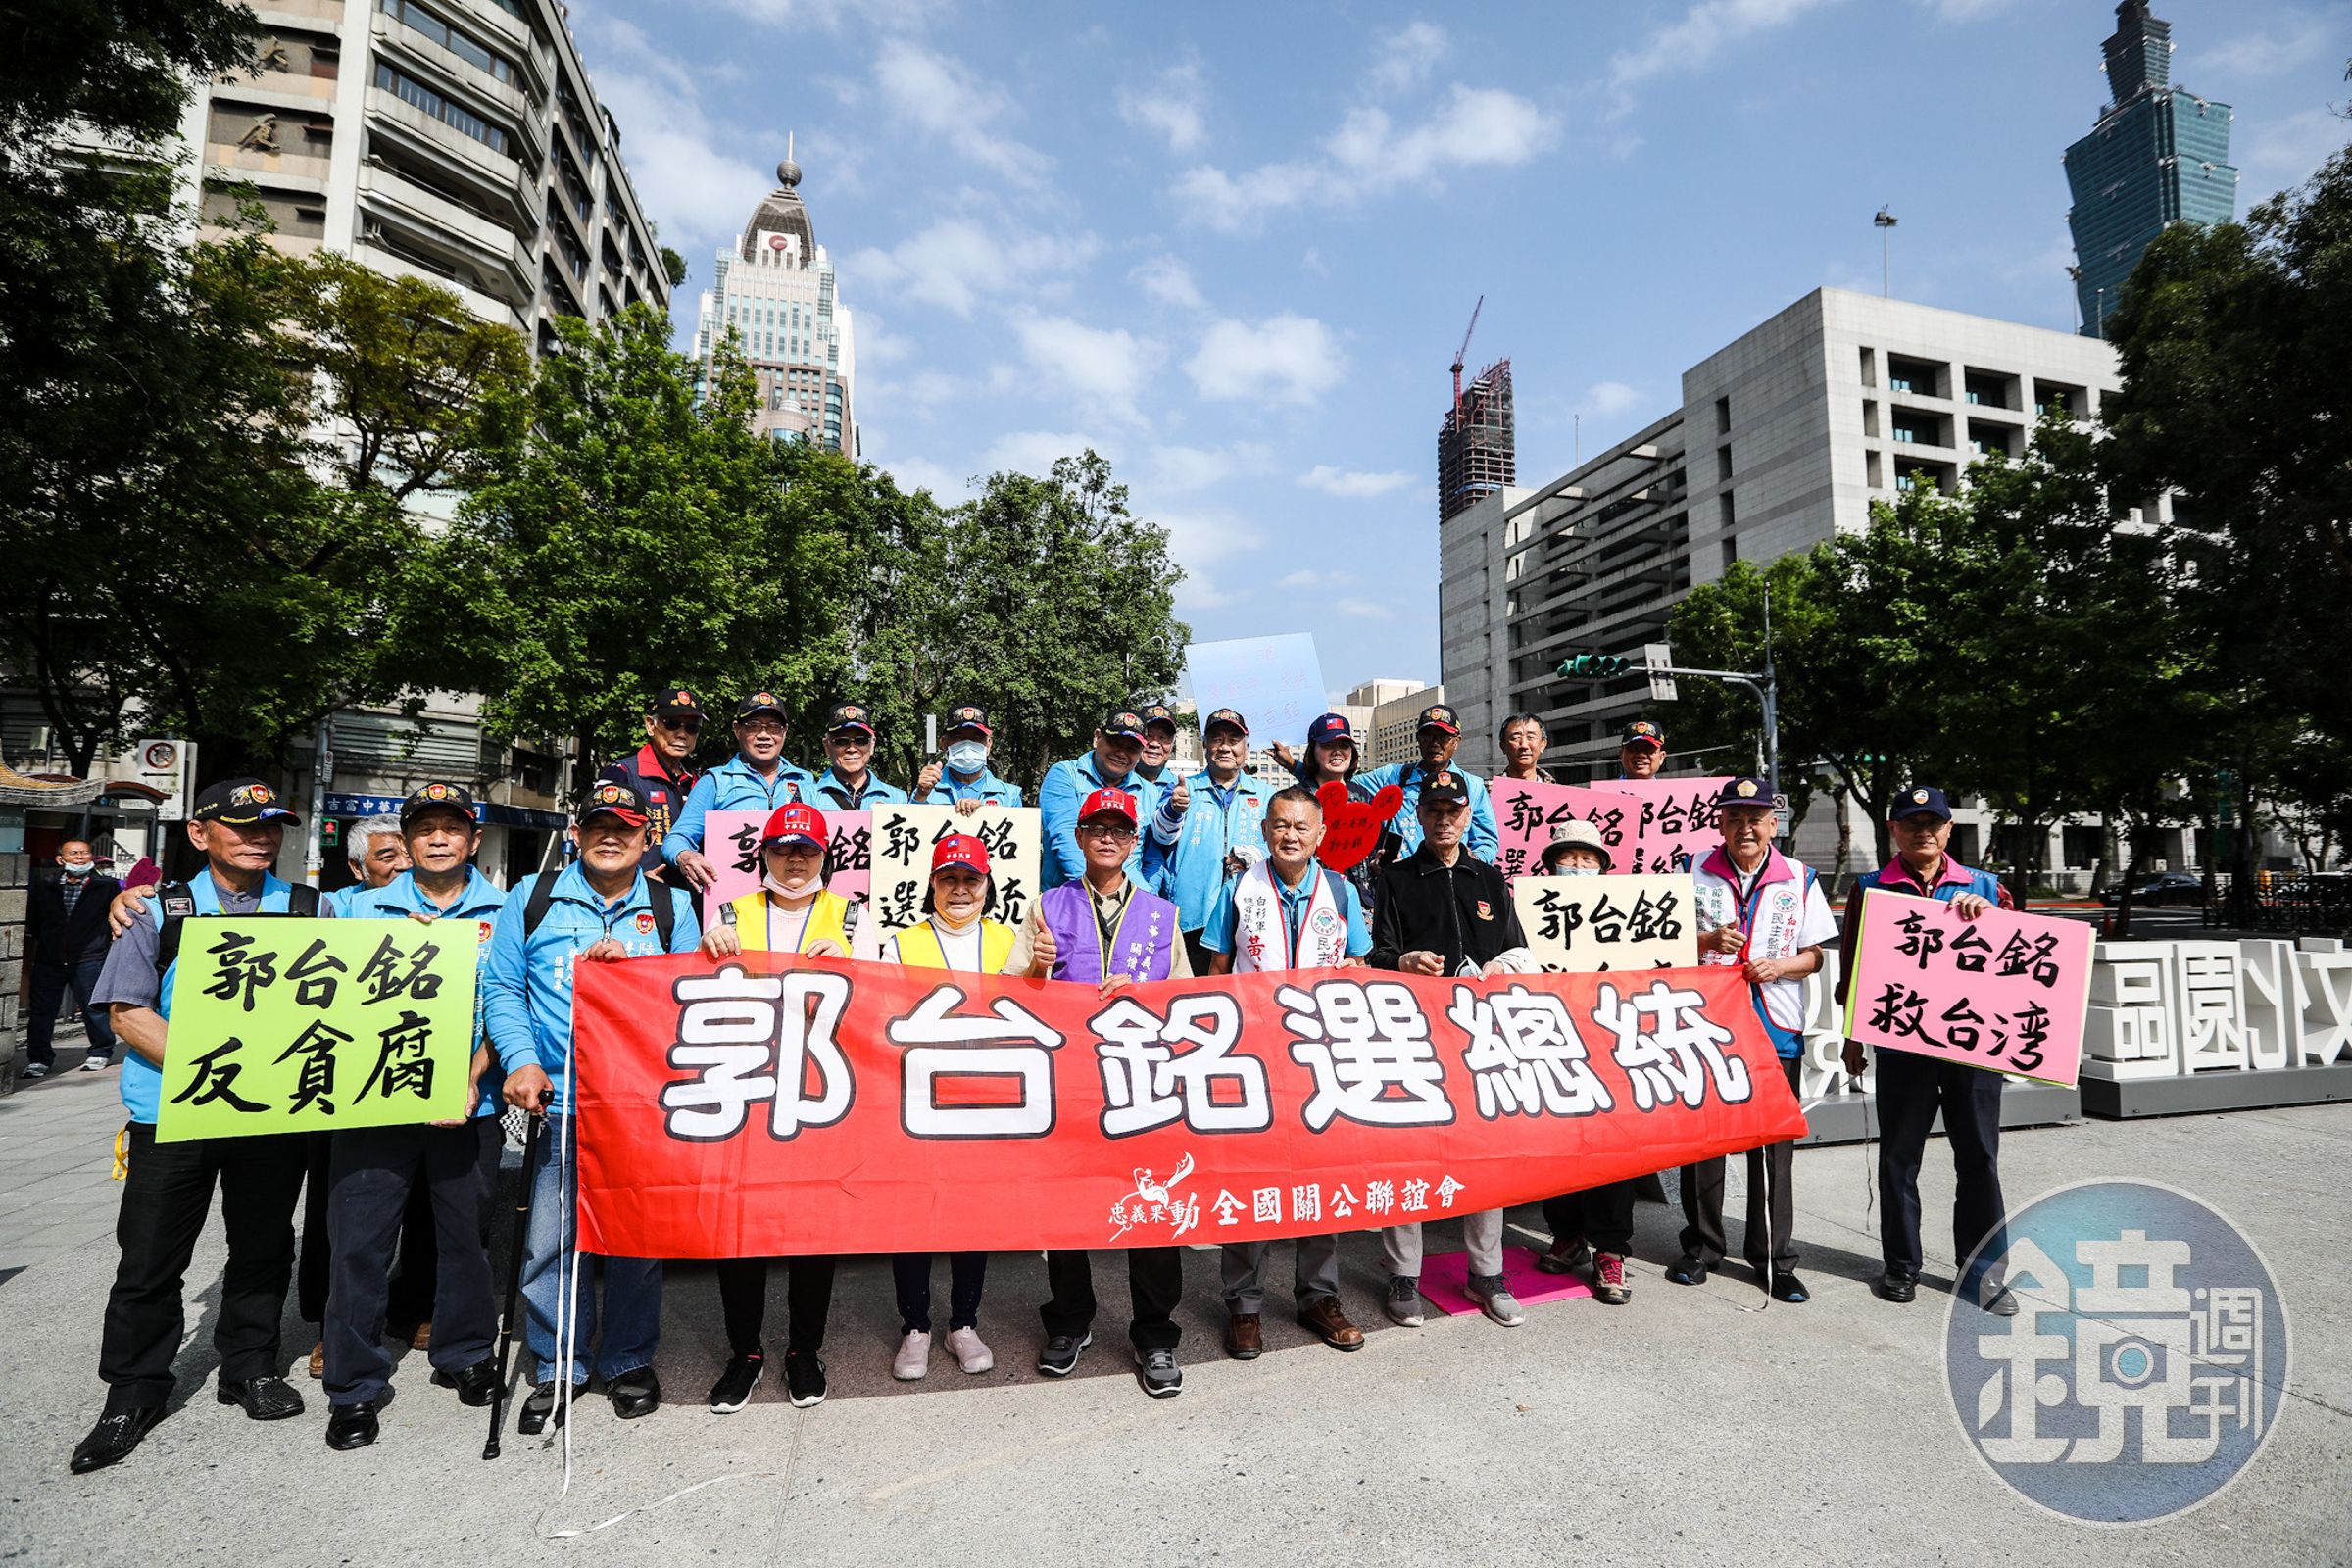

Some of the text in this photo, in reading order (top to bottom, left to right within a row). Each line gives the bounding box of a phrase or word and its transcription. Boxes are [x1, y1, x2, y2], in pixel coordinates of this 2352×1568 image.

[729, 823, 870, 874] 郭銘
[881, 813, 1018, 866] 郭銘
[879, 877, 1027, 929] 選統
[1254, 896, 1266, 933] 白衫軍
[1533, 889, 1682, 950] 郭台銘
[202, 932, 443, 1013] 郭台銘
[1893, 909, 2060, 988] 郭台銘
[171, 1010, 435, 1114] 反貪腐
[661, 963, 1752, 1141] 郭台銘選總統
[1108, 1174, 1466, 1241] 忠義果動 全國關公聯誼會
